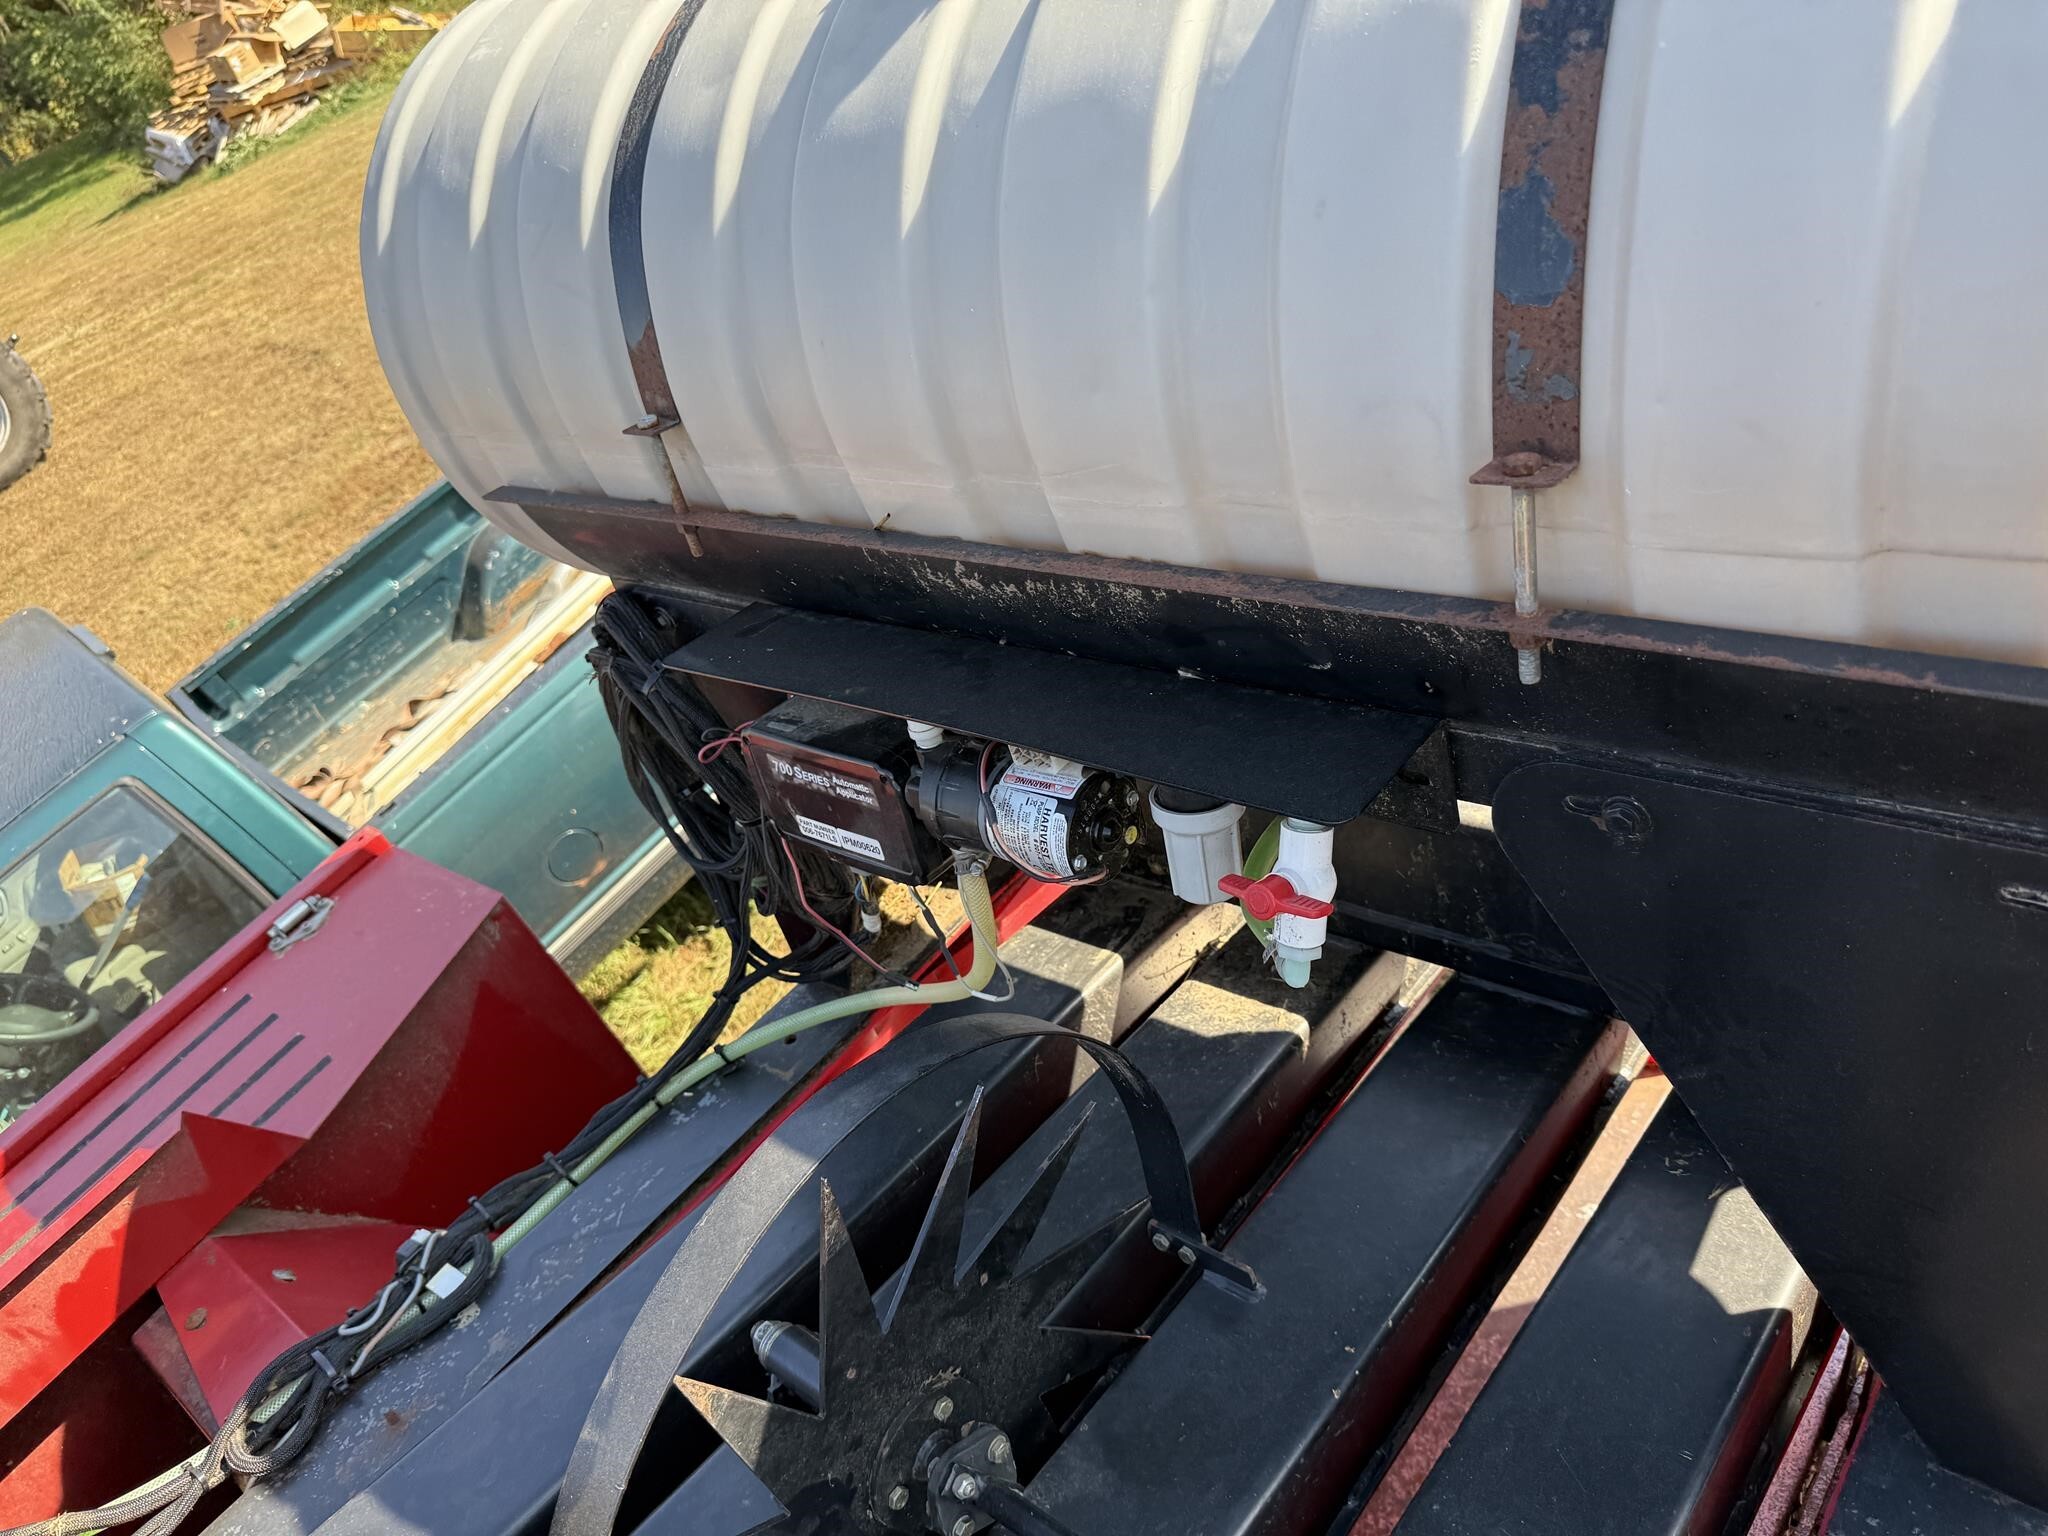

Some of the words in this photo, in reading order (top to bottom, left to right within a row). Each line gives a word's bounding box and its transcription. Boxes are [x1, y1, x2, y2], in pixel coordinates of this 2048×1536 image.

[772, 760, 792, 776] 700
[793, 767, 830, 787] SERIES
[832, 776, 870, 793] Automatic
[1014, 777, 1051, 790] WARNING
[836, 787, 873, 804] Applicator
[1040, 808, 1051, 860] HARVEST
